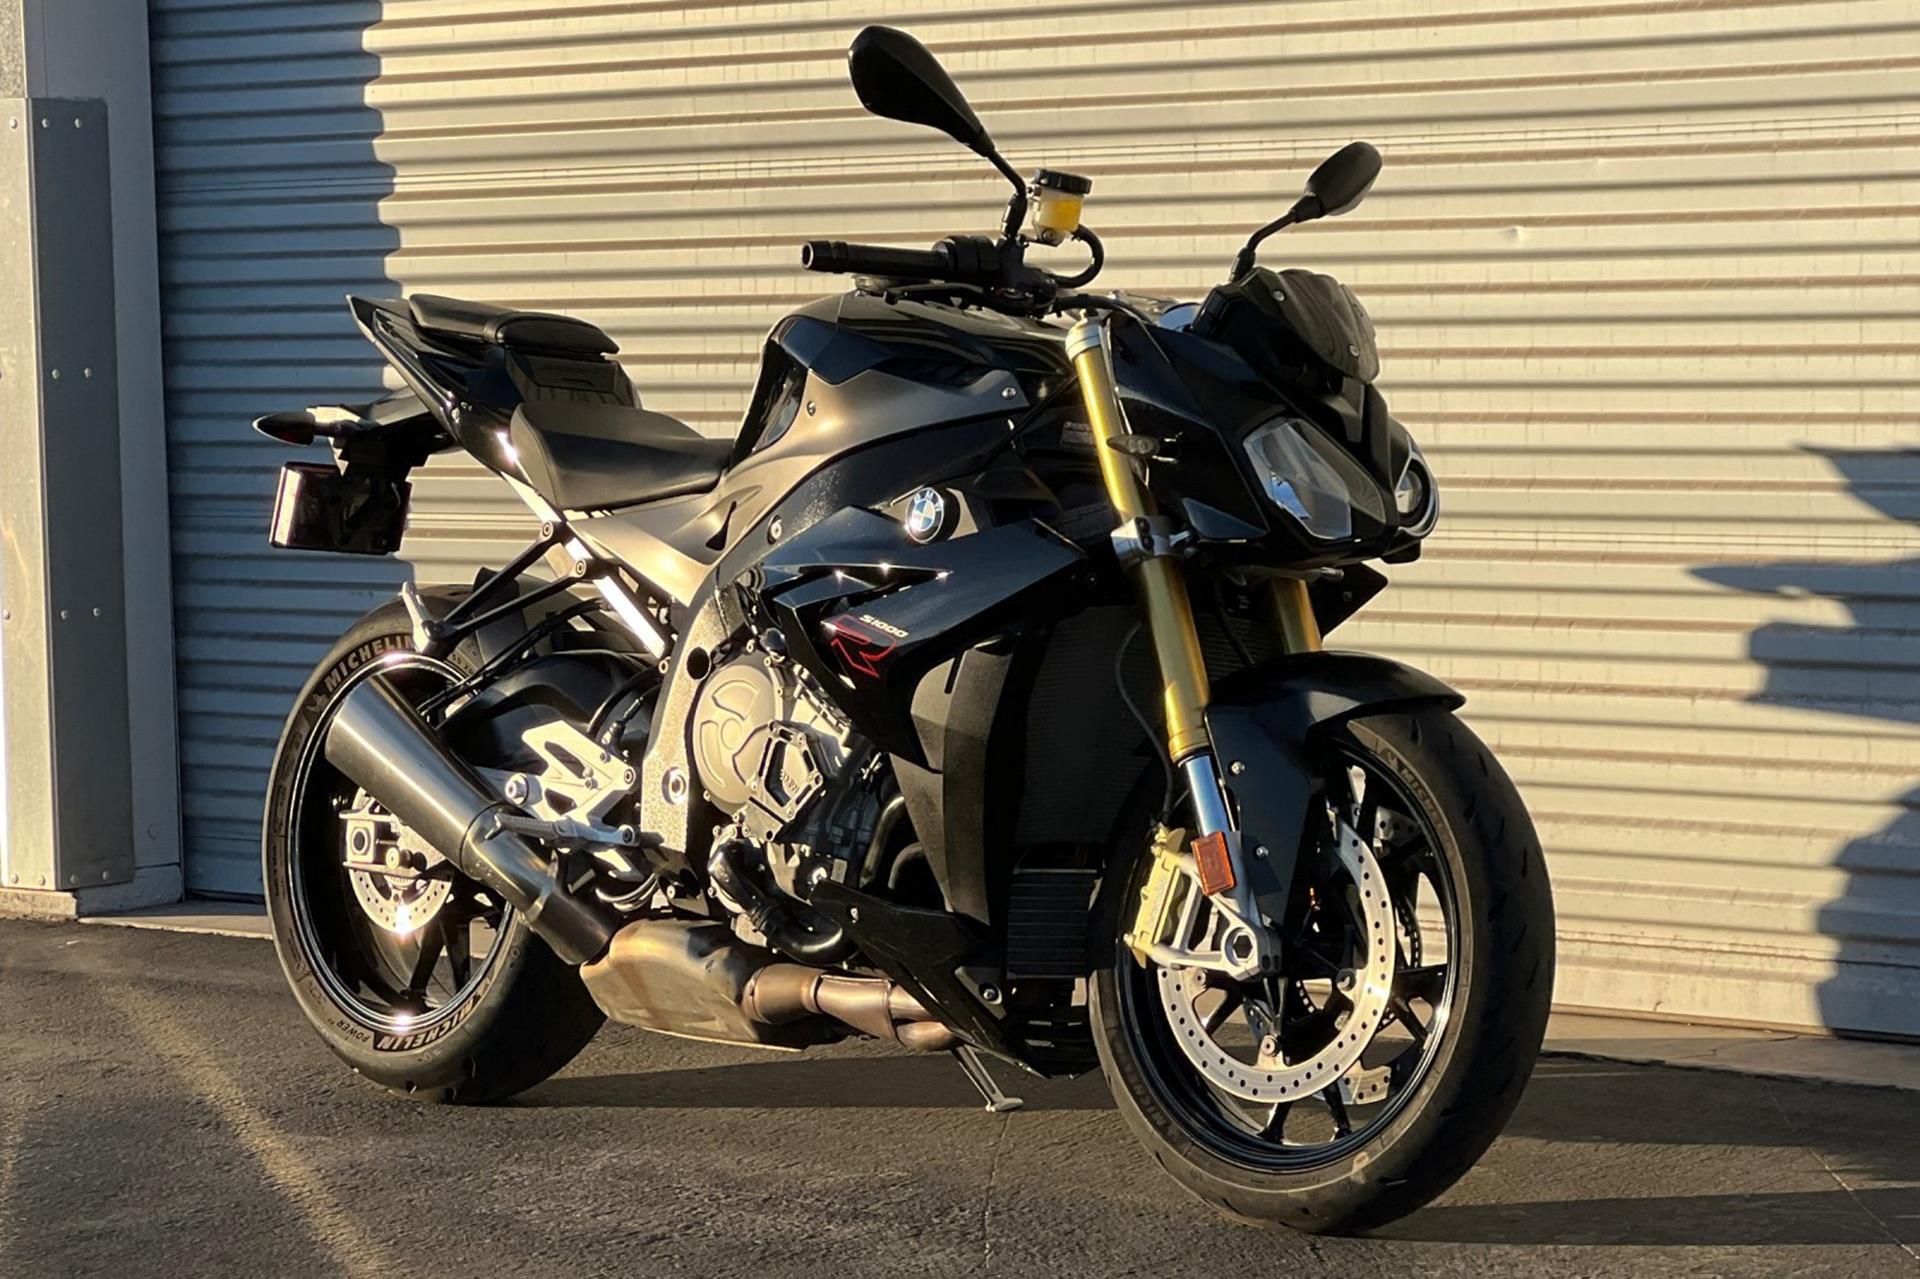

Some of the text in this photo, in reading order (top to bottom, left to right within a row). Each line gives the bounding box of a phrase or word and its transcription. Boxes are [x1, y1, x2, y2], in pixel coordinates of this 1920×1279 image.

[859, 614, 909, 638] S1000
[323, 635, 415, 692] MICHELIN
[336, 1018, 370, 1043] POWER
[377, 993, 475, 1050] MICHELIN
